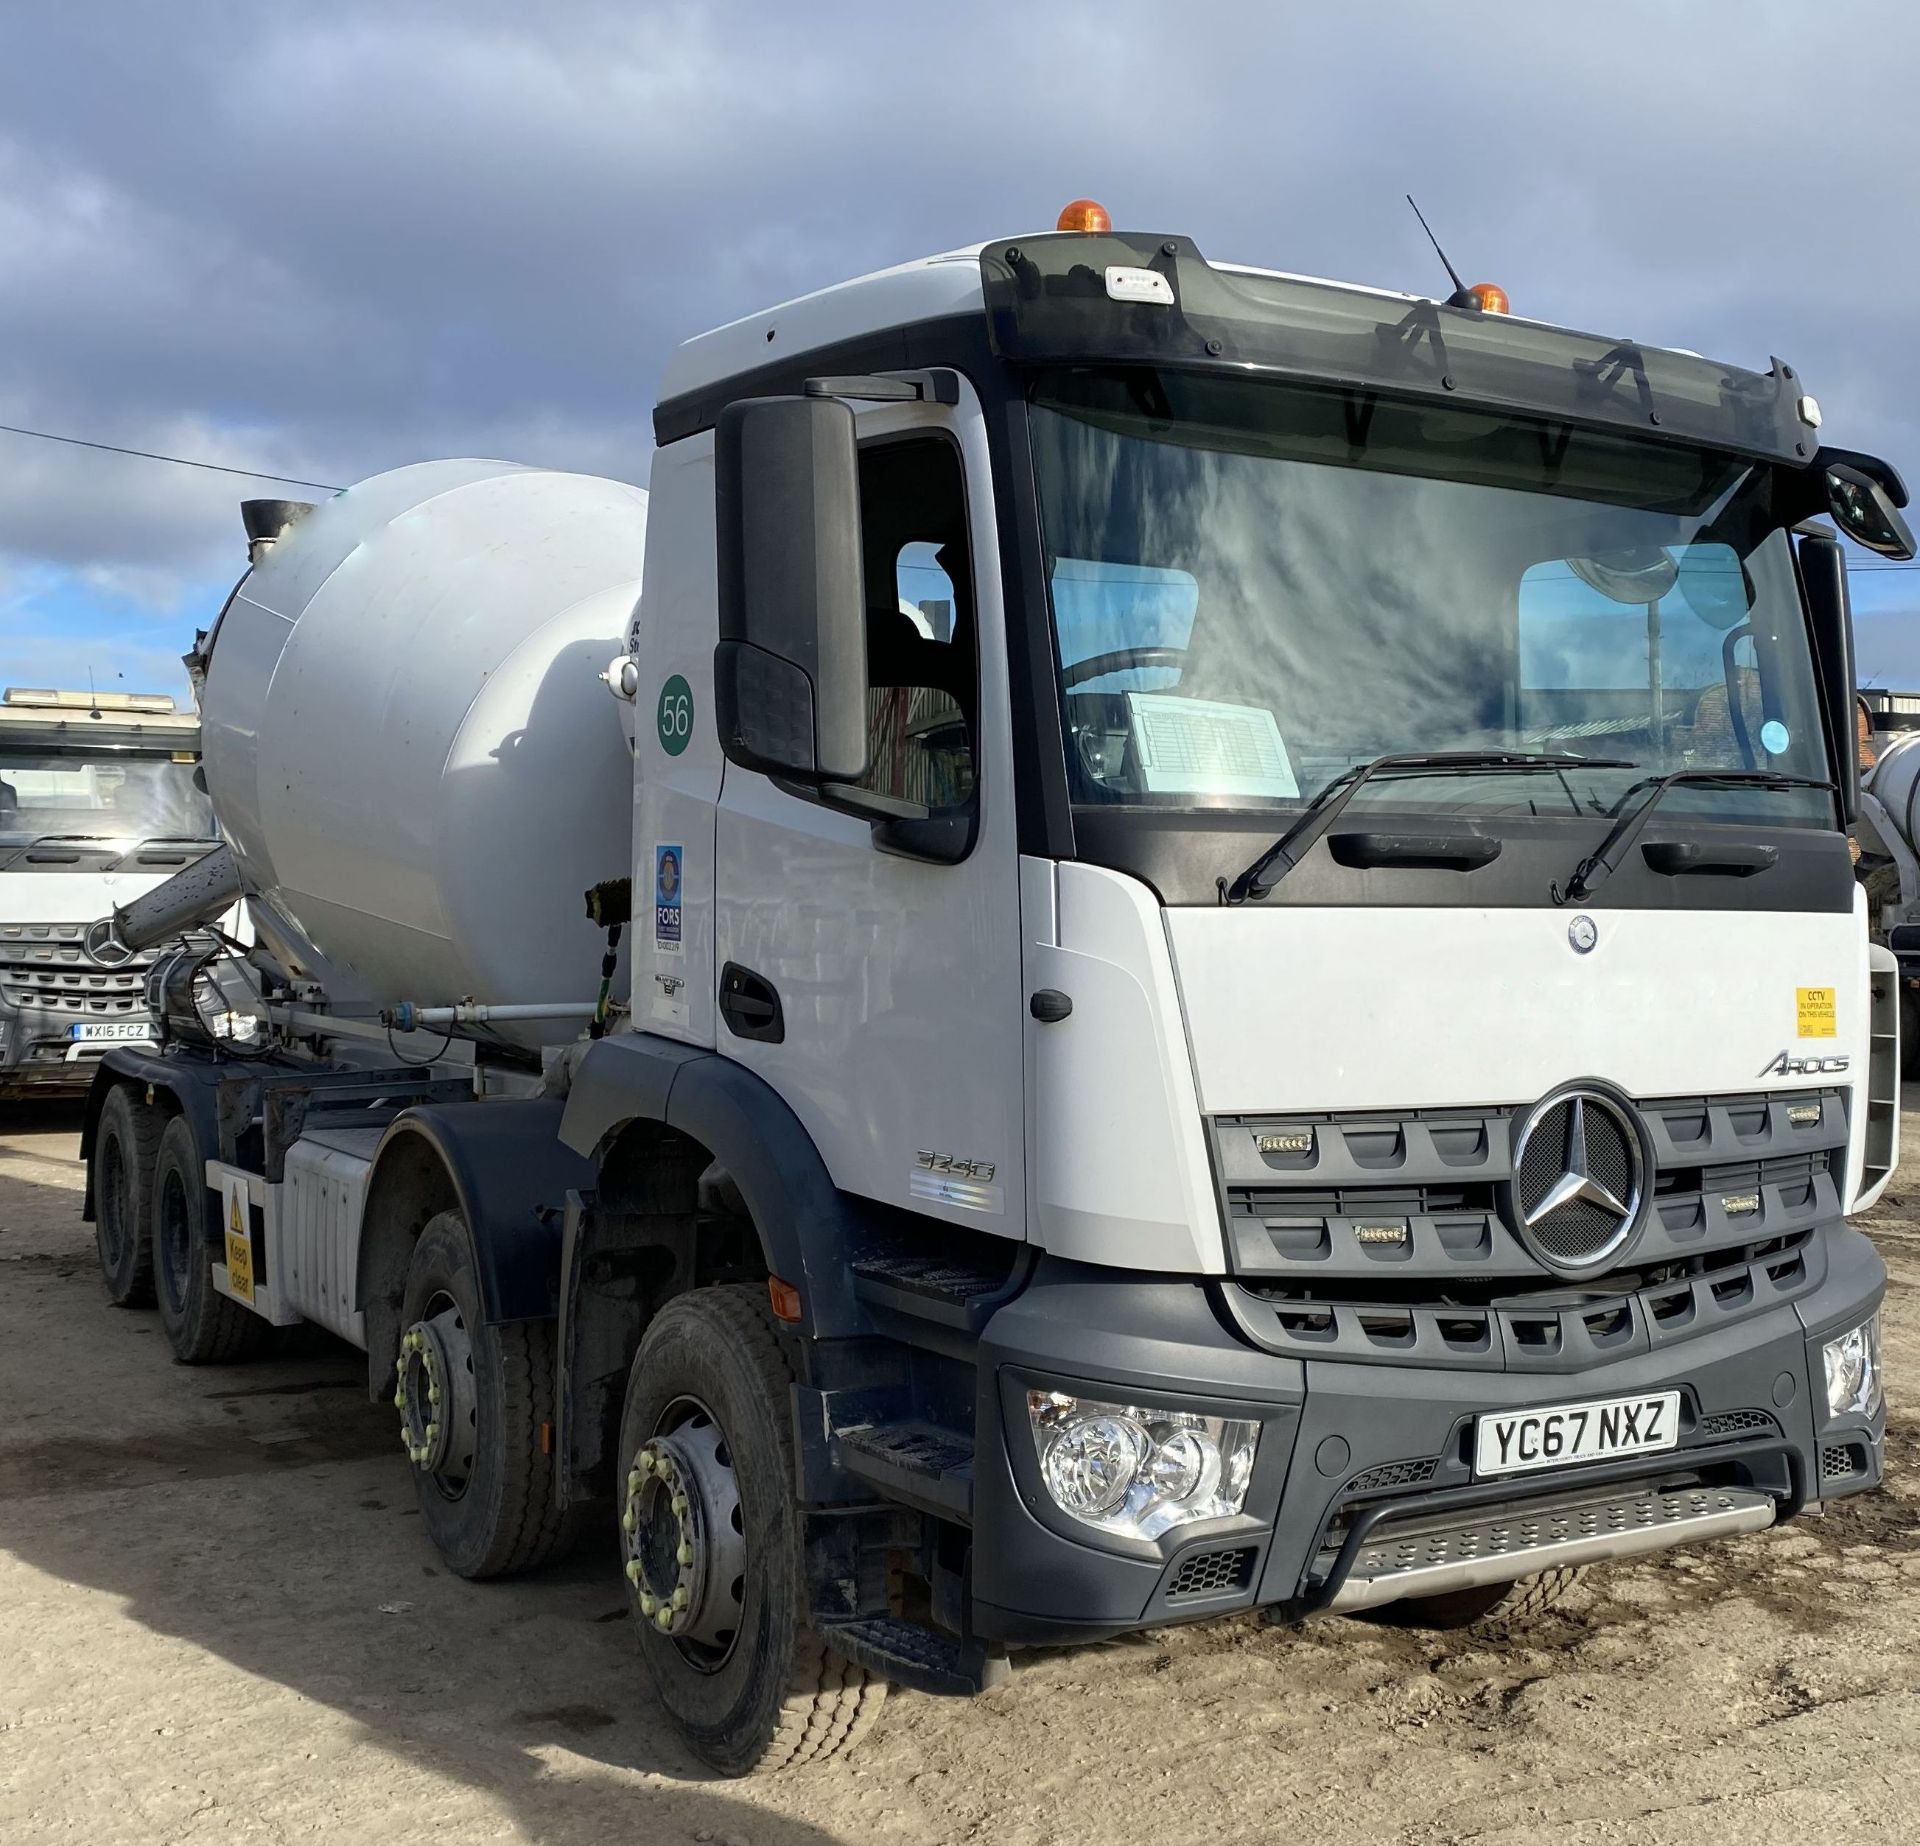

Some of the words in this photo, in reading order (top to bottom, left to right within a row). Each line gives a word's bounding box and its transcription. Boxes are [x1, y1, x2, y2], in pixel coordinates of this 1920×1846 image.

[662, 695, 689, 736] 56
[657, 907, 680, 926] FORS
[1808, 991, 1826, 1001] CCTV
[85, 1025, 115, 1037] WX16
[118, 1025, 144, 1037] FCZ
[230, 1238, 248, 1270] Keep
[231, 1268, 249, 1295] clear
[1496, 1411, 1589, 1465] YC67
[1600, 1400, 1665, 1449] NXZ
